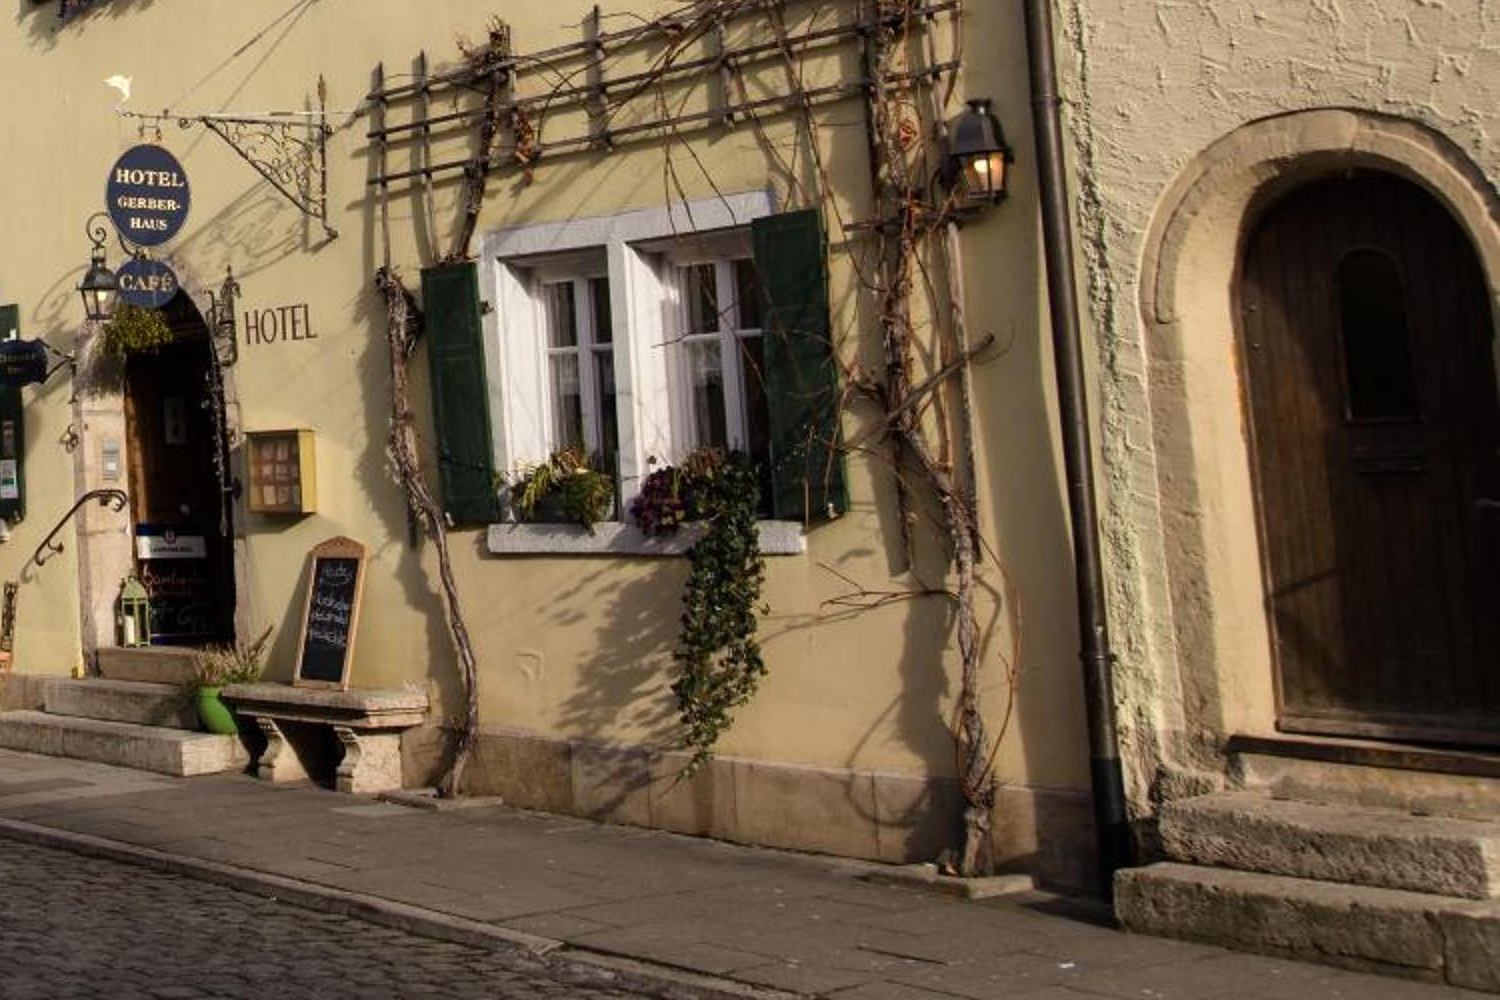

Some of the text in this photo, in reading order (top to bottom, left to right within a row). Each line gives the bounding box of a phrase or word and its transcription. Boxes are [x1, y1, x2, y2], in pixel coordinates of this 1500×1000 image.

[116, 168, 185, 188] HOTEL
[117, 195, 181, 211] GERBER-
[130, 217, 168, 231] HAUS
[119, 271, 173, 292] CAFÉ
[244, 303, 319, 345] HOTEL
